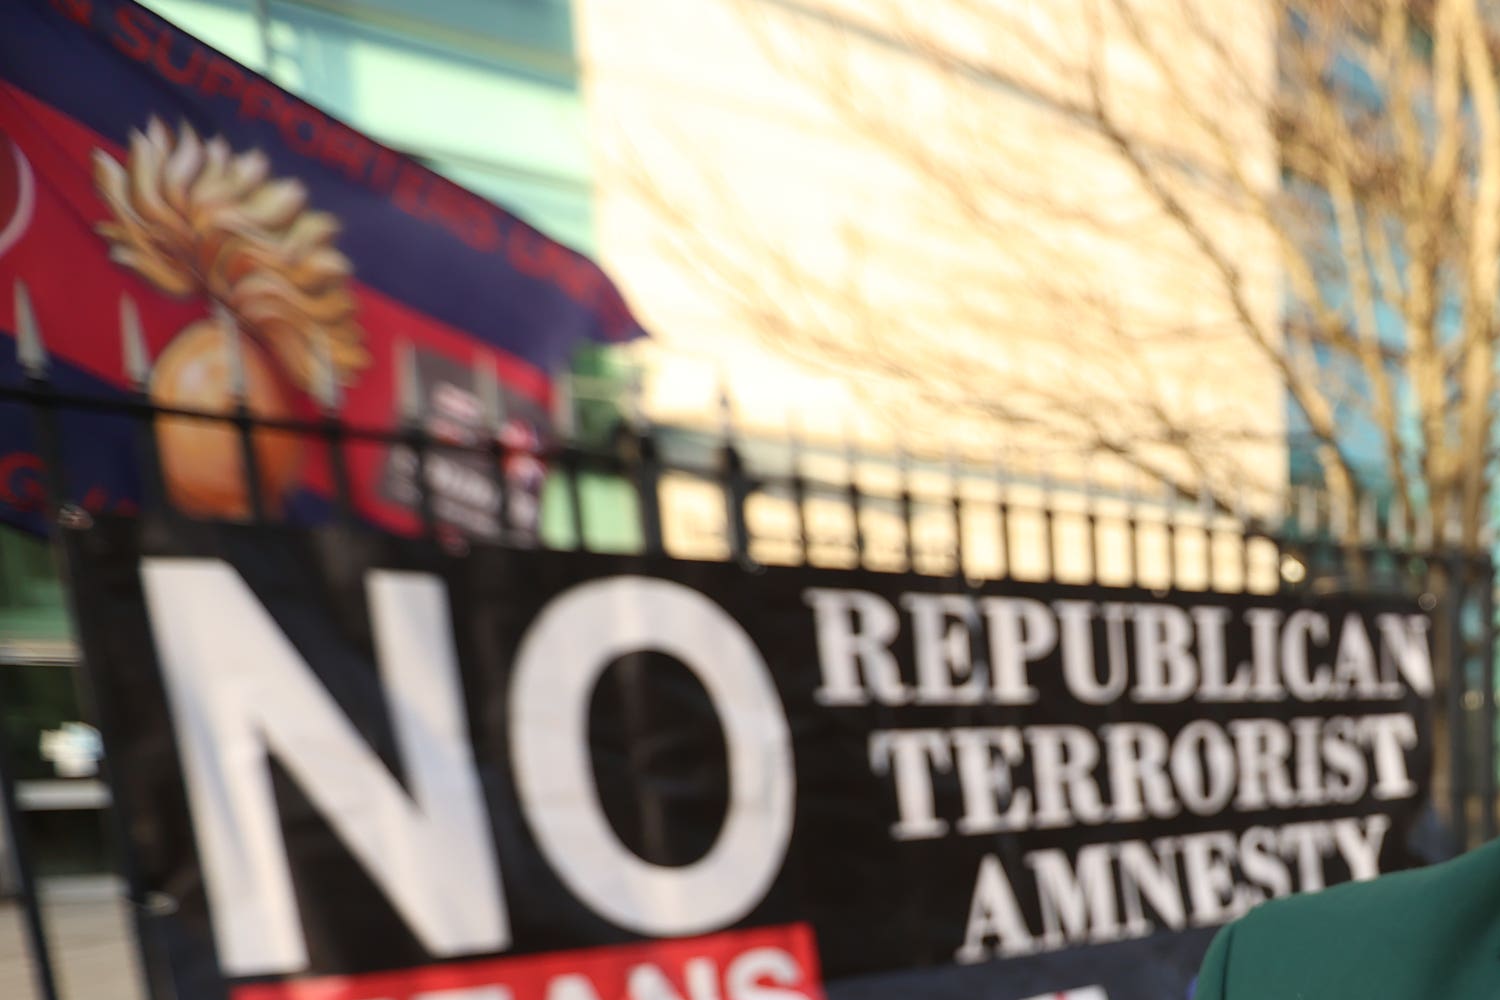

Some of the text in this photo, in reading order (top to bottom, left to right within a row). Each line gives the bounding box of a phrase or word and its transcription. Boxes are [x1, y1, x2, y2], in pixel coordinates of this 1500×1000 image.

[803, 587, 1435, 706] REPUBLICAN
[138, 556, 797, 977] NO
[867, 712, 1418, 842] TERRORIST
[956, 812, 1391, 964] AMNESTY
